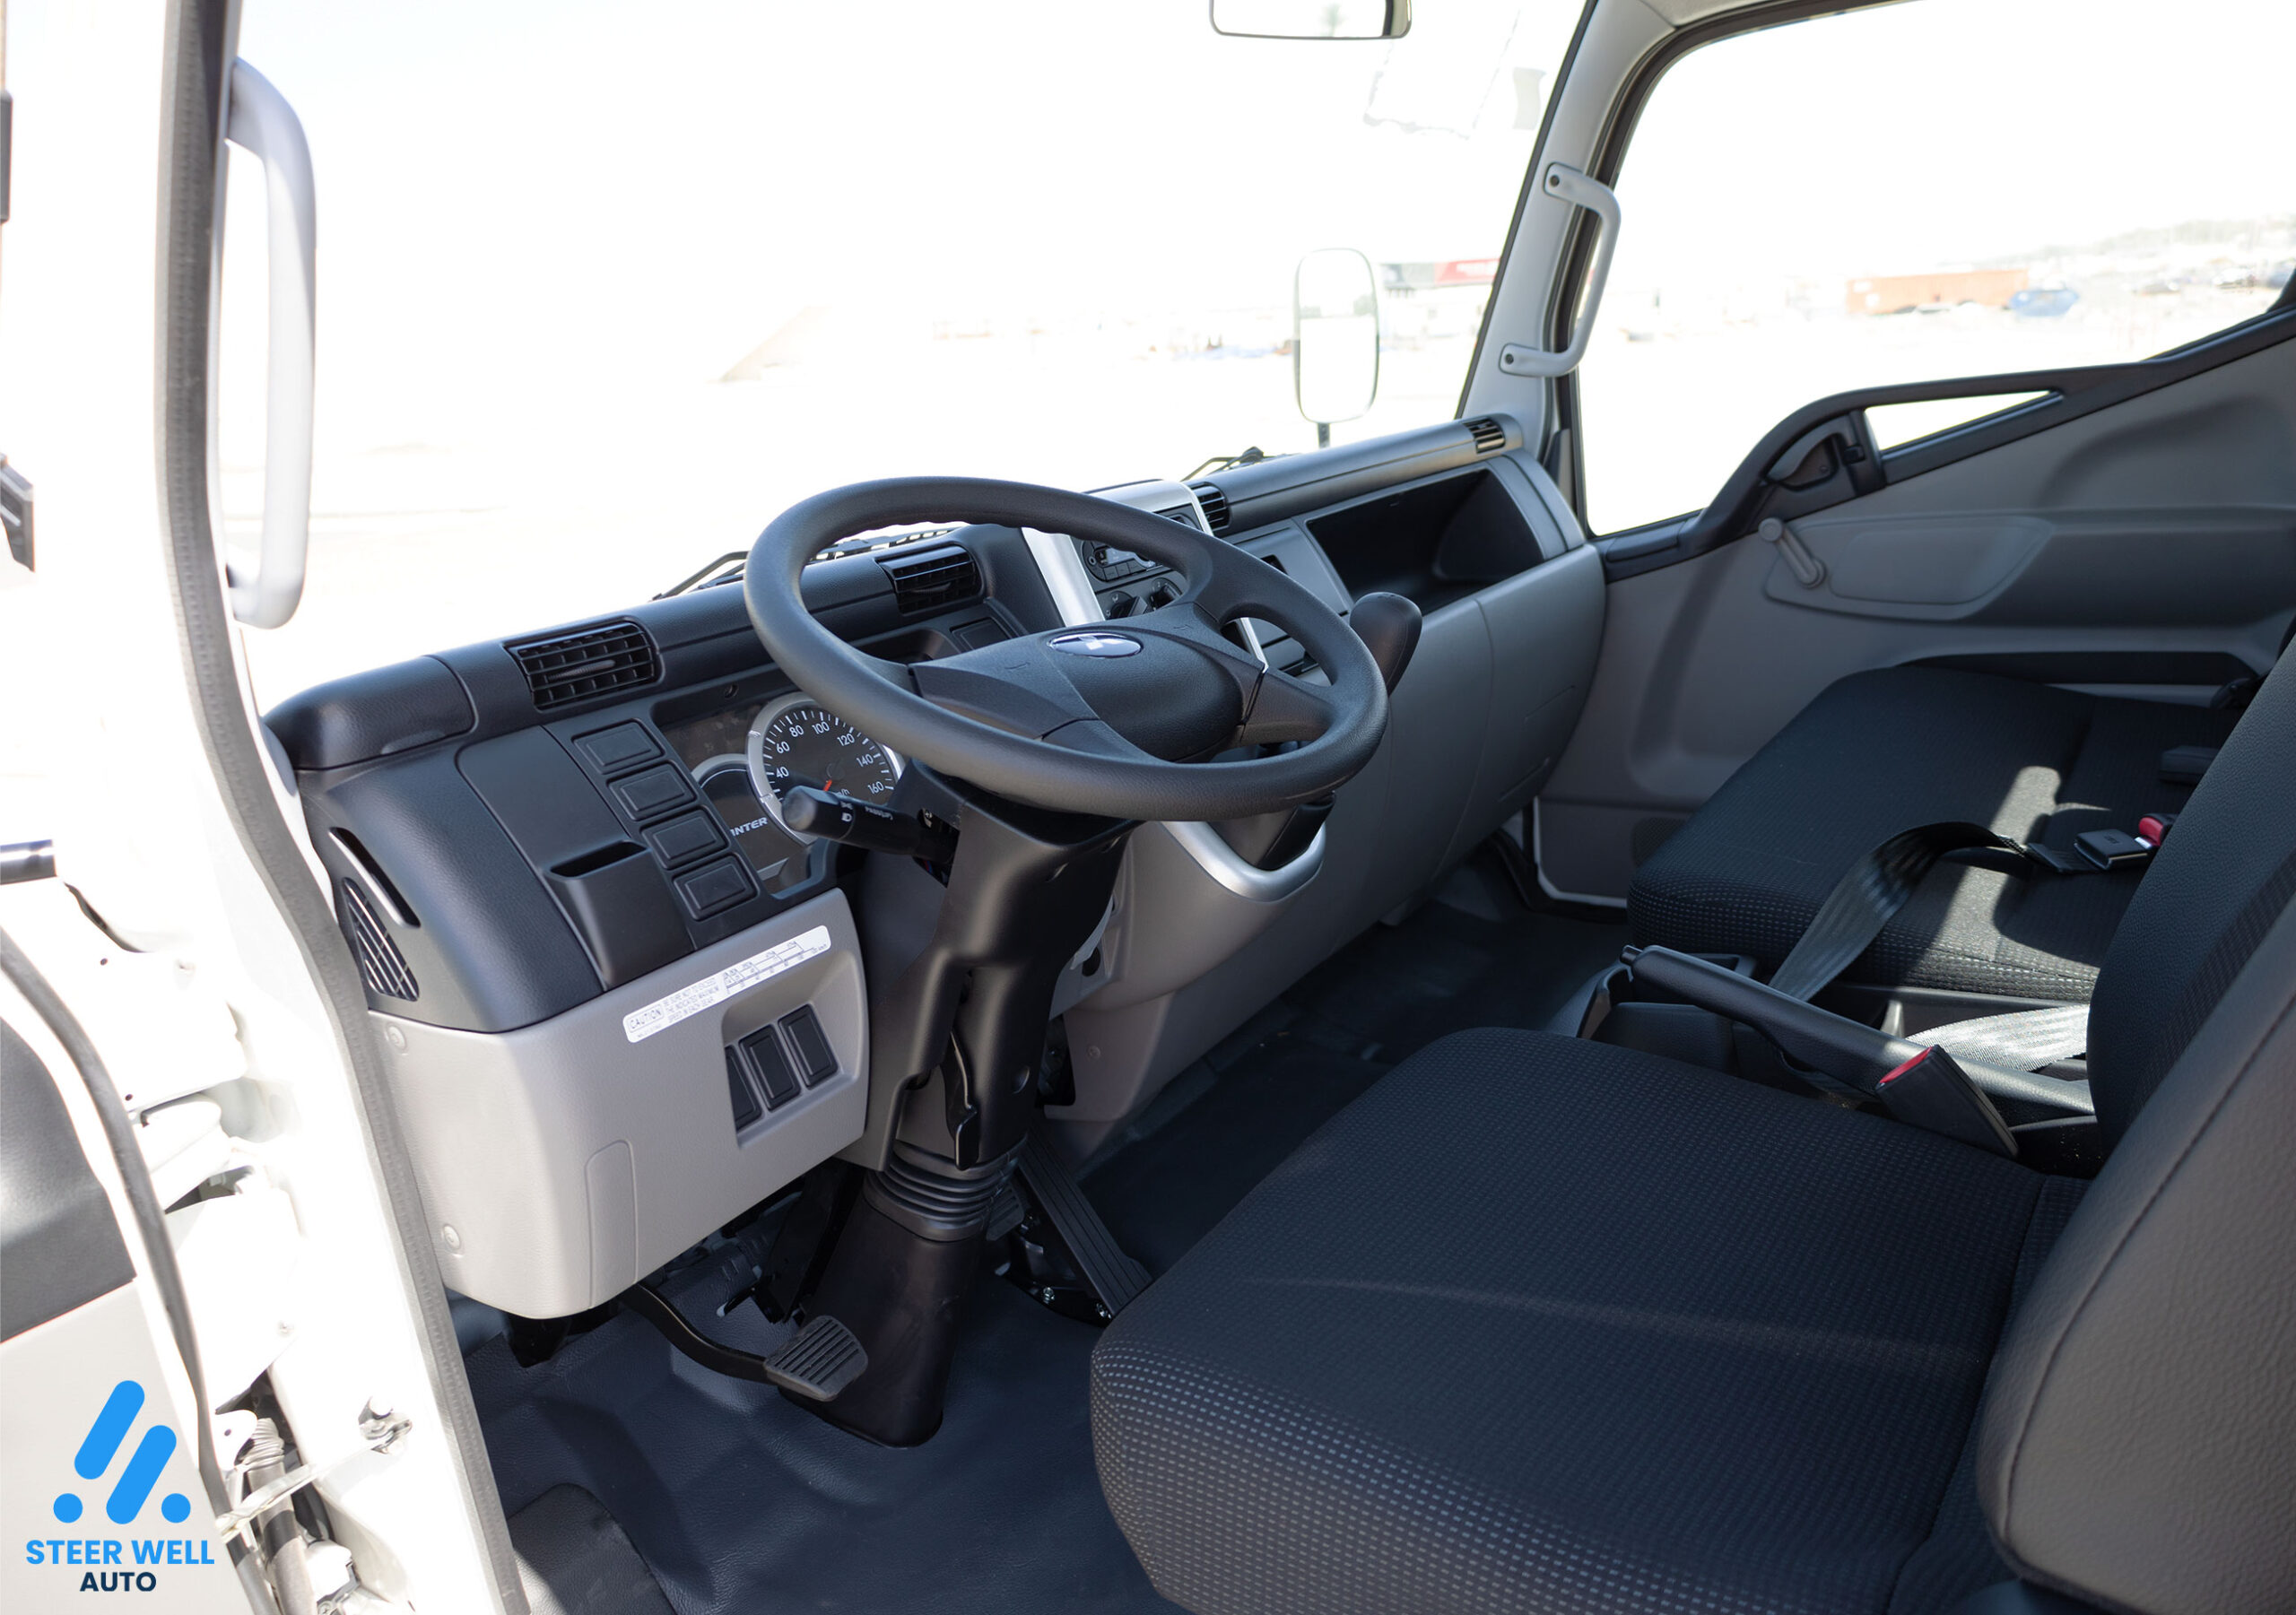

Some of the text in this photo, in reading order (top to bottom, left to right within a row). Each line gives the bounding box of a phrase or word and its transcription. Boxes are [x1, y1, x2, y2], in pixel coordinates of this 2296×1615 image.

[788, 725, 804, 738] 80
[812, 721, 830, 735] 100
[837, 734, 856, 747] 120
[776, 742, 790, 754] 60
[856, 754, 874, 768] 140
[776, 766, 789, 778] 40
[867, 781, 884, 794] 160
[631, 1008, 662, 1030] CAUTION
